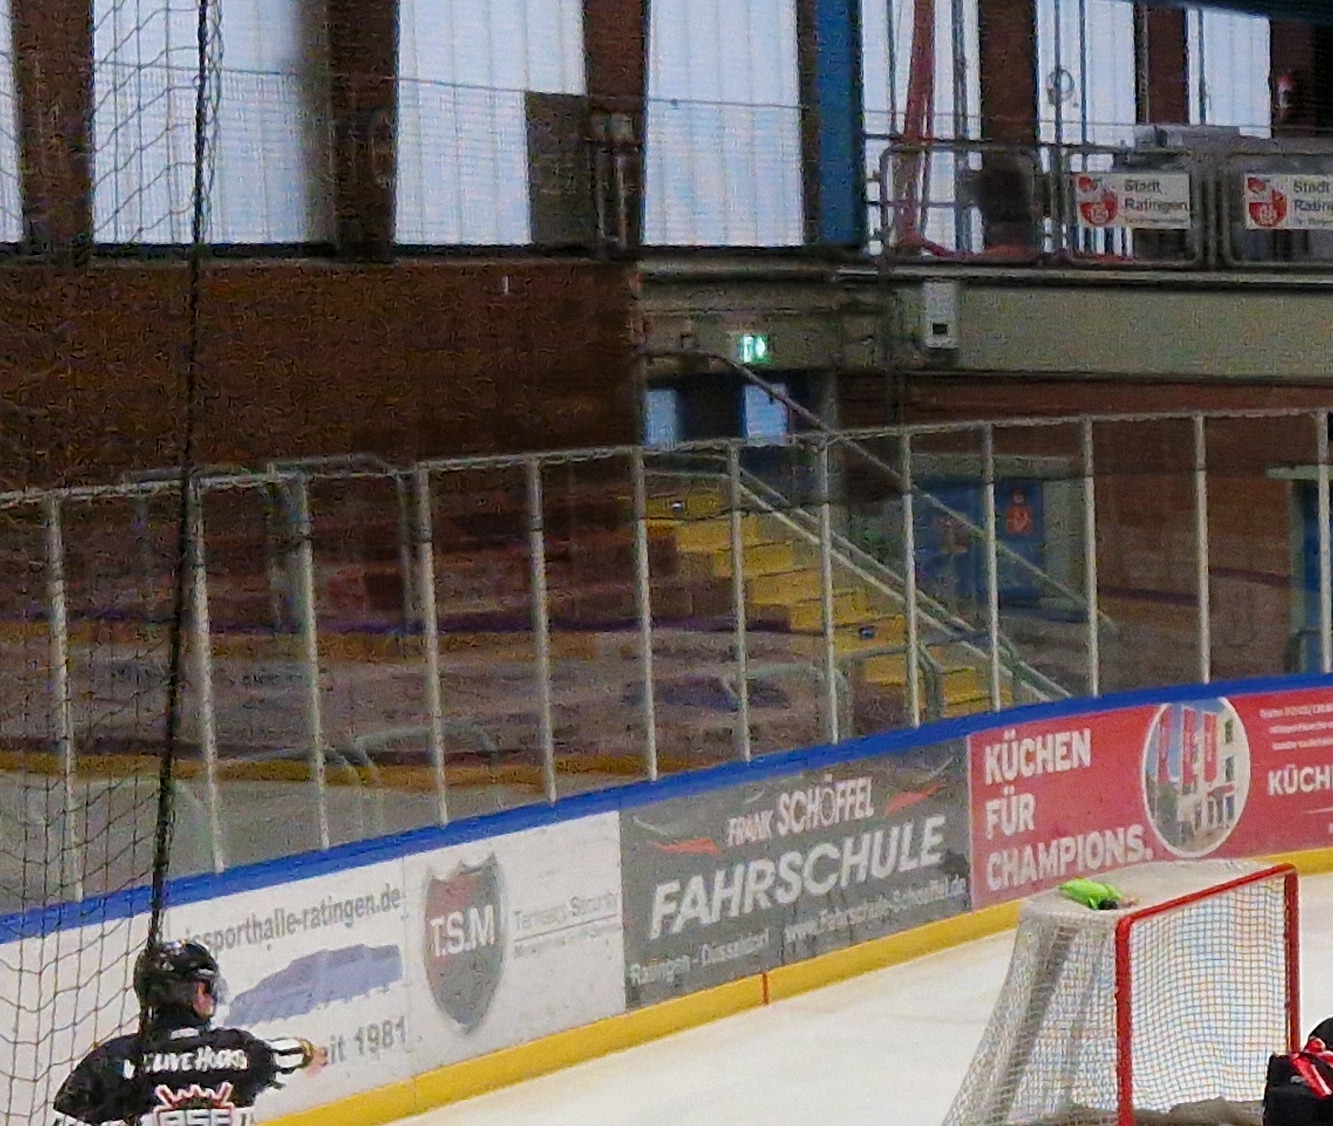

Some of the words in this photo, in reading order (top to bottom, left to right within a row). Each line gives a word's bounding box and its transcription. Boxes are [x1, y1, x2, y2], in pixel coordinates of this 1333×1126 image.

[984, 727, 1092, 786] KÜCHEN
[725, 810, 775, 847] FRANK
[777, 774, 874, 836] SCHÖFFEL
[985, 785, 1036, 840] FÜR
[650, 814, 946, 940] FAHRSCHULE
[986, 824, 1154, 892] CHAMPIONS.
[353, 1015, 405, 1056] 1981
